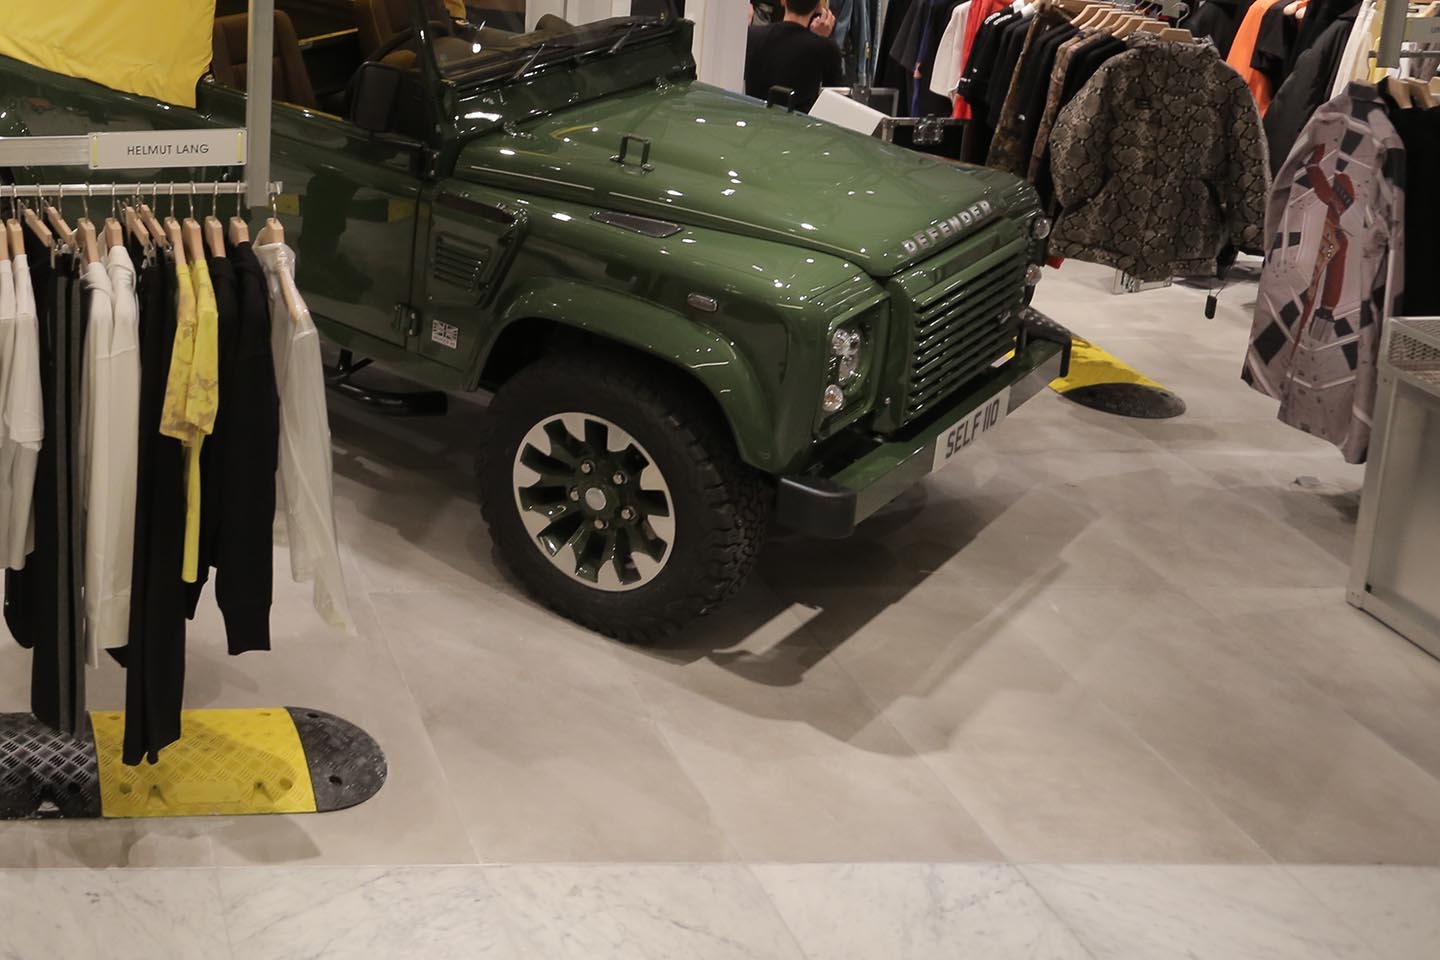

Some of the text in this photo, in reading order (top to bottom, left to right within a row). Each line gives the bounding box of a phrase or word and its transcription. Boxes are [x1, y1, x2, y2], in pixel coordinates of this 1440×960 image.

[127, 143, 210, 156] HELMUT LANG
[901, 200, 993, 257] DEFENDER
[945, 398, 1000, 459] SELF 110
